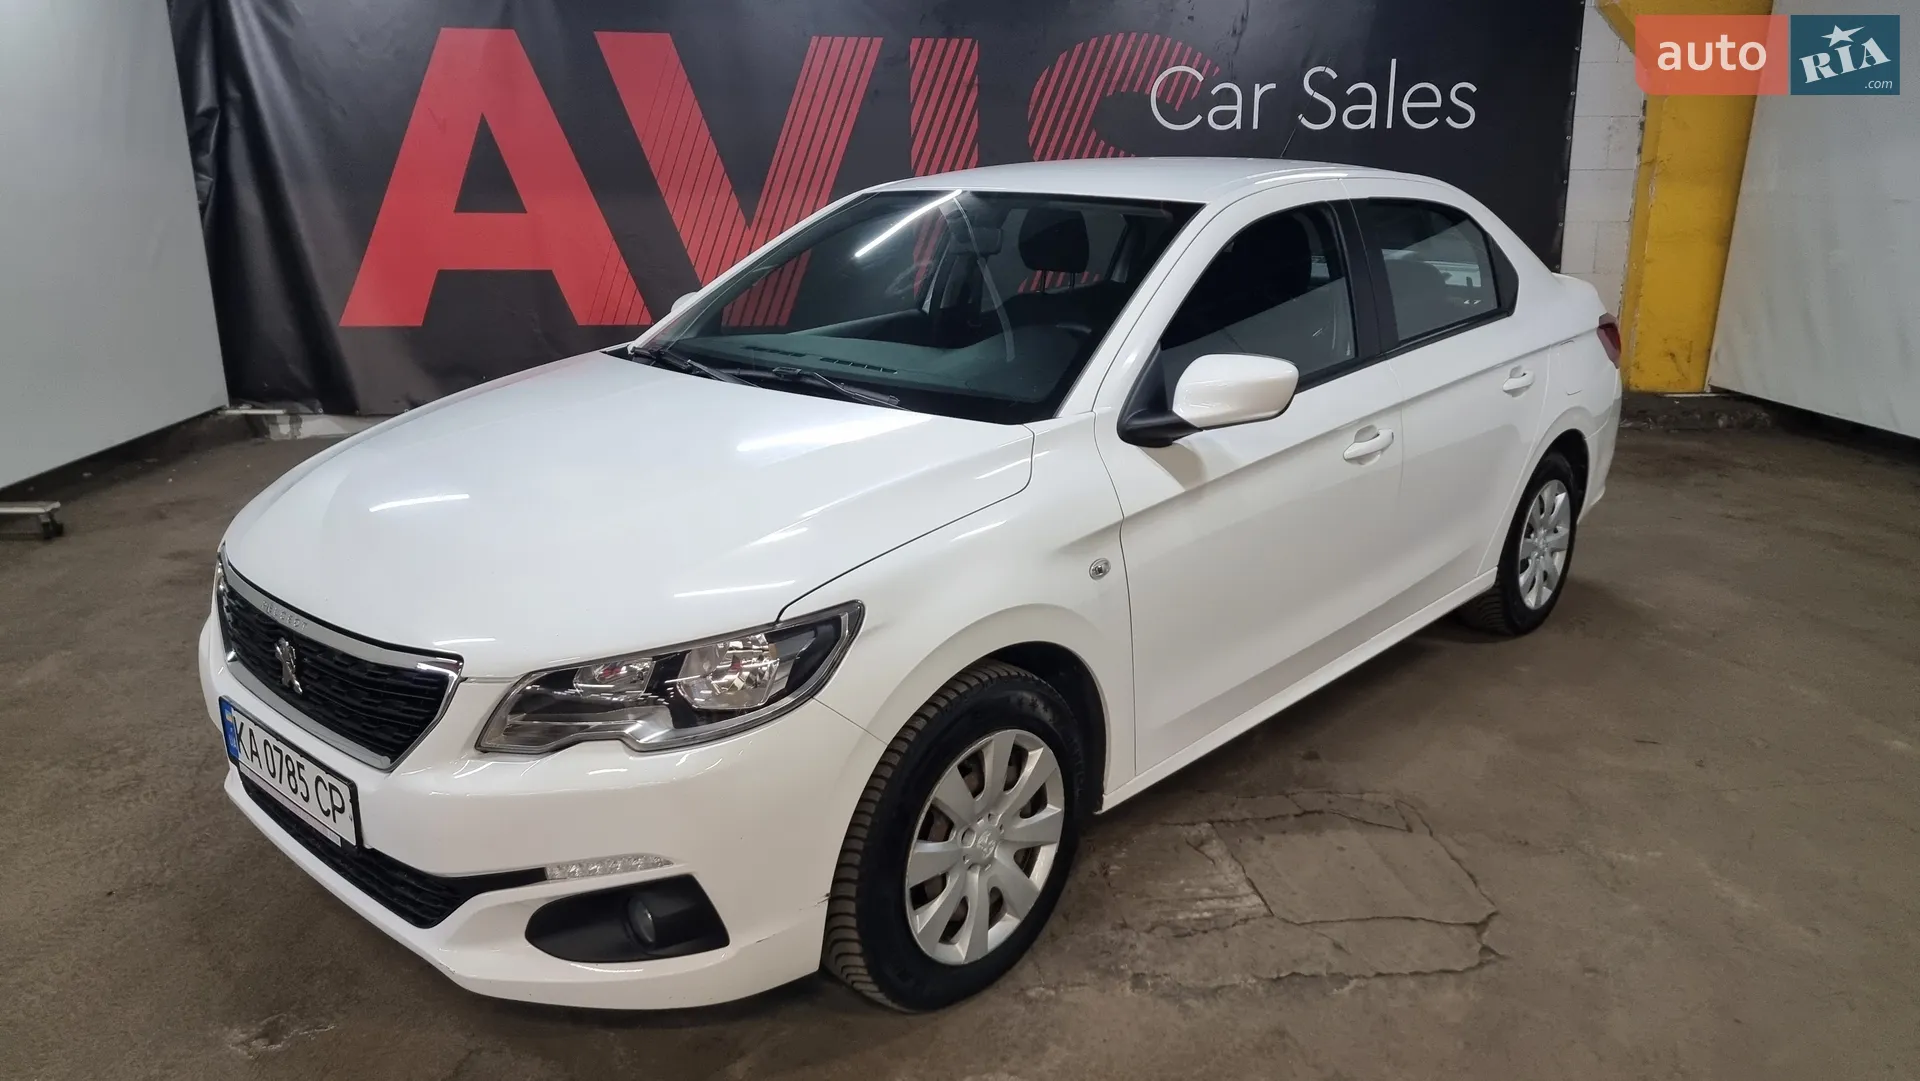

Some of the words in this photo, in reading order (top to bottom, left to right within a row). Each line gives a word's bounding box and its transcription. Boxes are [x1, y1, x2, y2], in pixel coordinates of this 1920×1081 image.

[1149, 66, 1276, 130] Car
[1298, 58, 1477, 130] Sales
[232, 716, 263, 769] KA
[264, 739, 310, 801] 0785
[314, 774, 346, 824] CP
